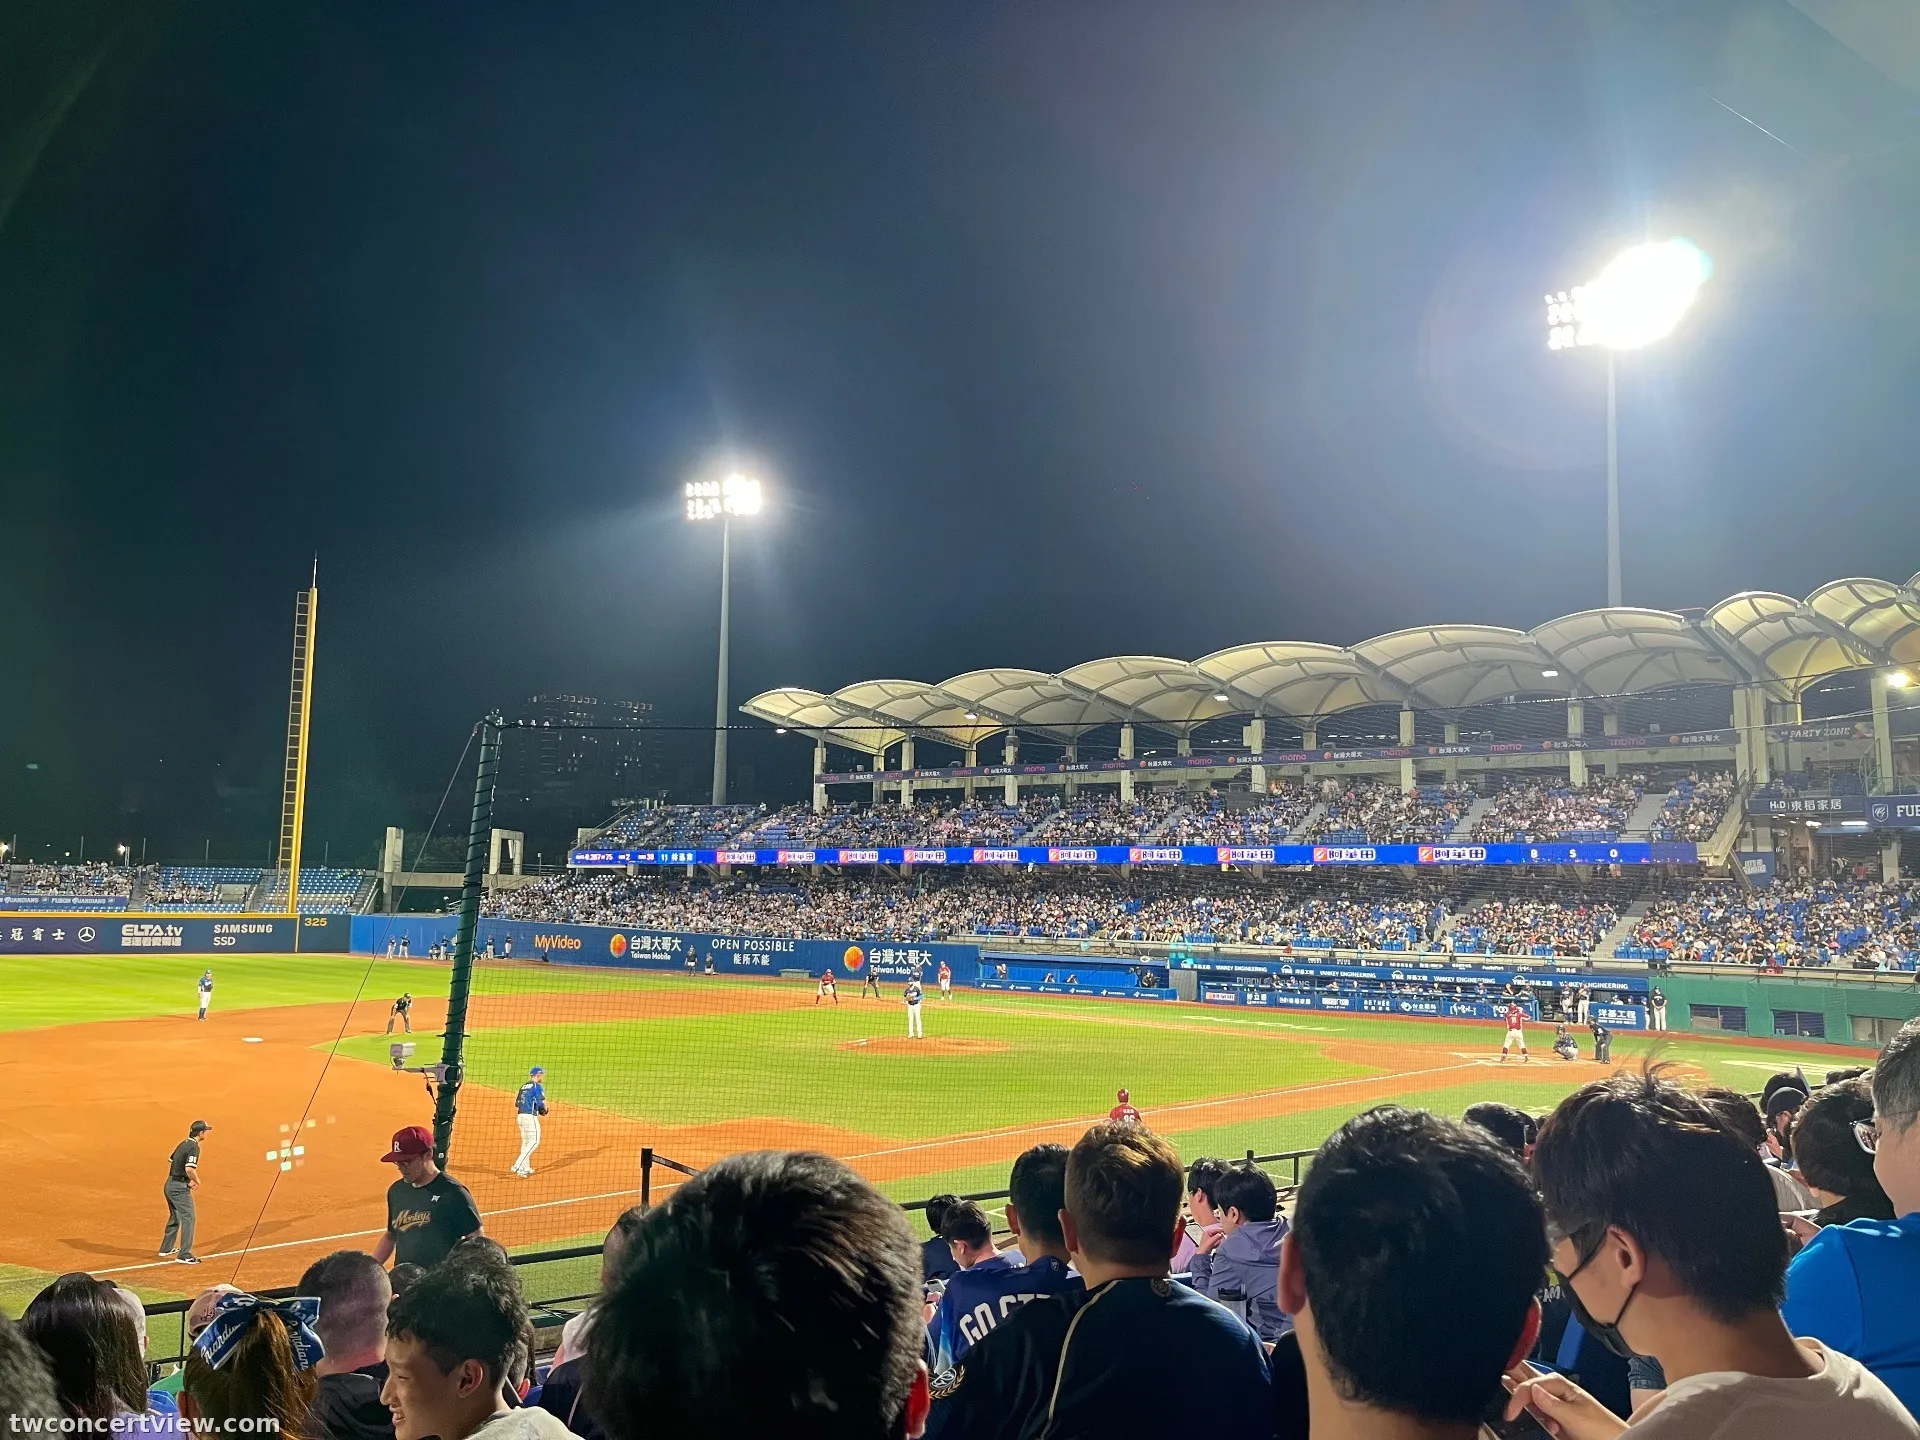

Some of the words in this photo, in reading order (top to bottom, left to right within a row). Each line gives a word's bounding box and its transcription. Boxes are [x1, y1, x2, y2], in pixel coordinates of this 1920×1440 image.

[1789, 729, 1821, 738] PARTY
[1823, 727, 1851, 736] ZONE
[304, 917, 328, 926] 325
[121, 924, 184, 936] ELTA.tv
[213, 924, 273, 934] SAMSUNG
[213, 936, 236, 946] SSD
[534, 934, 582, 952] MyVideo
[631, 935, 682, 951] 台灣大哥大
[711, 938, 740, 950] OPEN
[744, 940, 795, 952] POSSIBLE
[630, 951, 651, 960] Taiwan
[652, 952, 672, 961] Mobile
[733, 952, 770, 966] 能所不能
[869, 948, 932, 966] 台灣大哥大
[1234, 965, 1268, 973] ENGINEERING
[1340, 971, 1376, 979] ENGINEERING
[1598, 1008, 1636, 1018] 洋基工程
[393, 1141, 402, 1152] R
[392, 1209, 431, 1229] Monkeys
